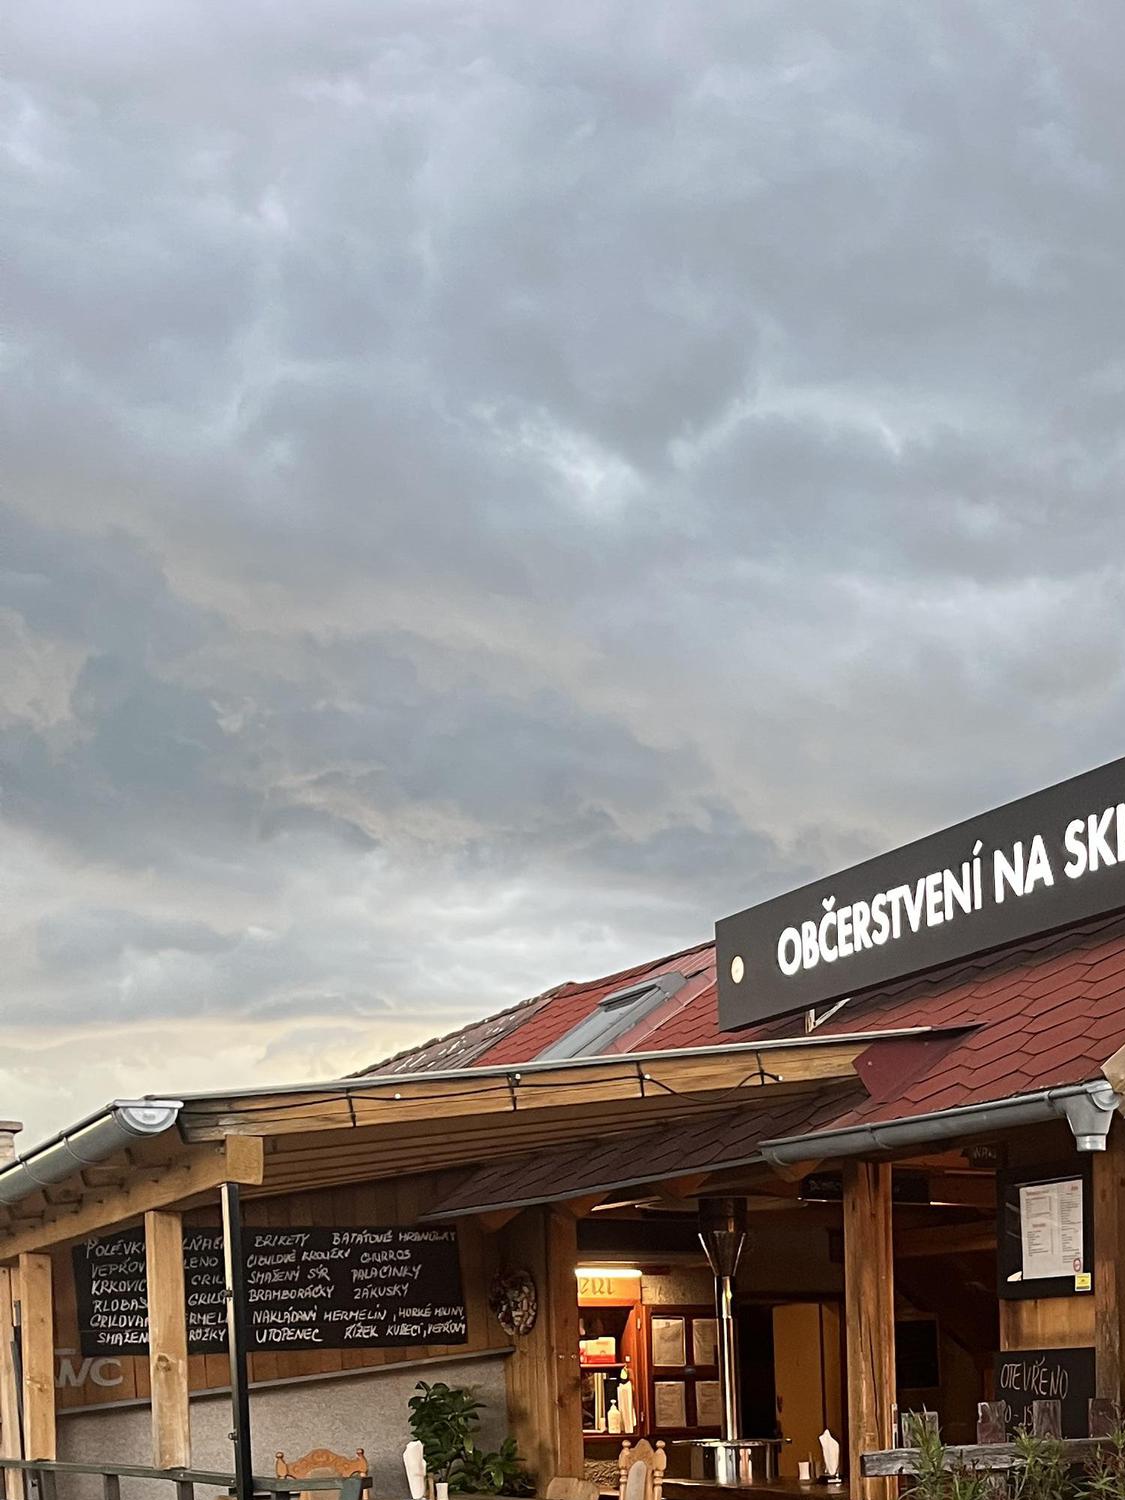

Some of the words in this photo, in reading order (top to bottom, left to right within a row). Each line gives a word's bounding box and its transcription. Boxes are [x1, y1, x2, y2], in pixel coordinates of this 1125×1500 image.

[777, 840, 983, 977] OBČERSTVENÍ
[993, 834, 1054, 904] NA
[91, 1257, 146, 1279] VEPŘOV
[91, 1279, 147, 1296] KRKOVIC
[97, 1330, 150, 1346] SMAŽEN
[1000, 1355, 1069, 1400] OTEVŘENO
